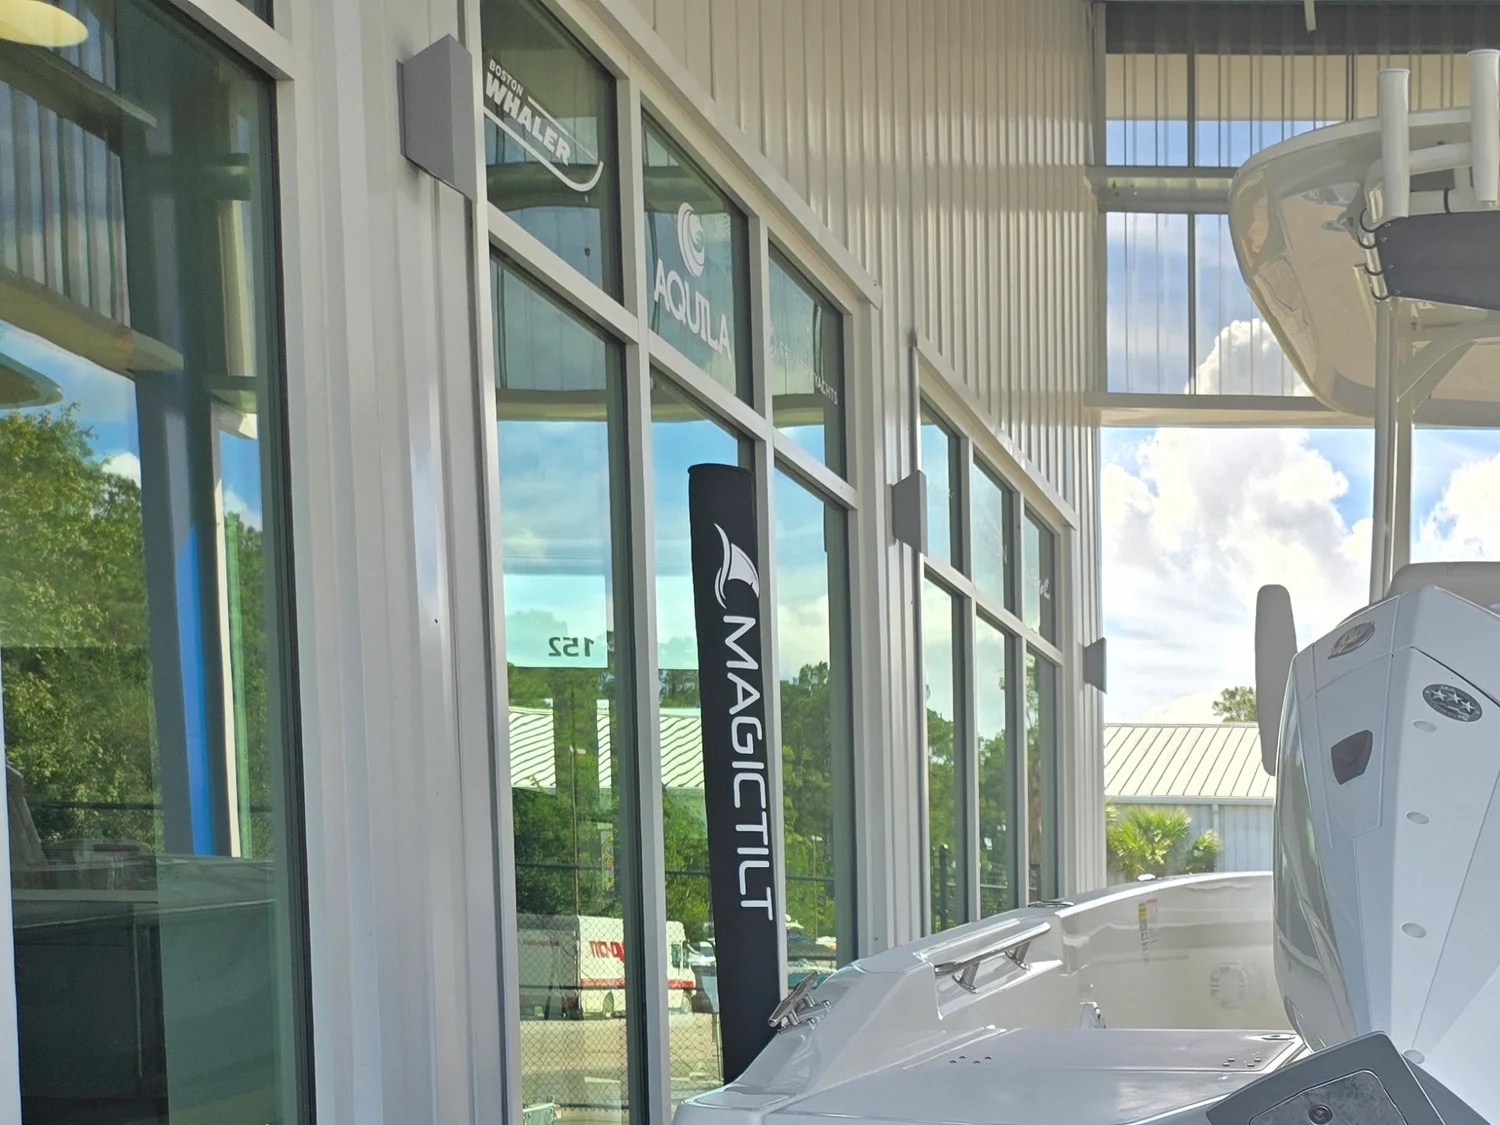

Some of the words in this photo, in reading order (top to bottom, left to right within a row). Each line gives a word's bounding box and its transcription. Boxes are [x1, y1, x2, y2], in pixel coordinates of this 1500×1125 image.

[485, 72, 571, 167] WHALER
[489, 59, 524, 97] BOSTON
[654, 257, 733, 364] AQUILA
[723, 614, 774, 922] MAGICTILT
